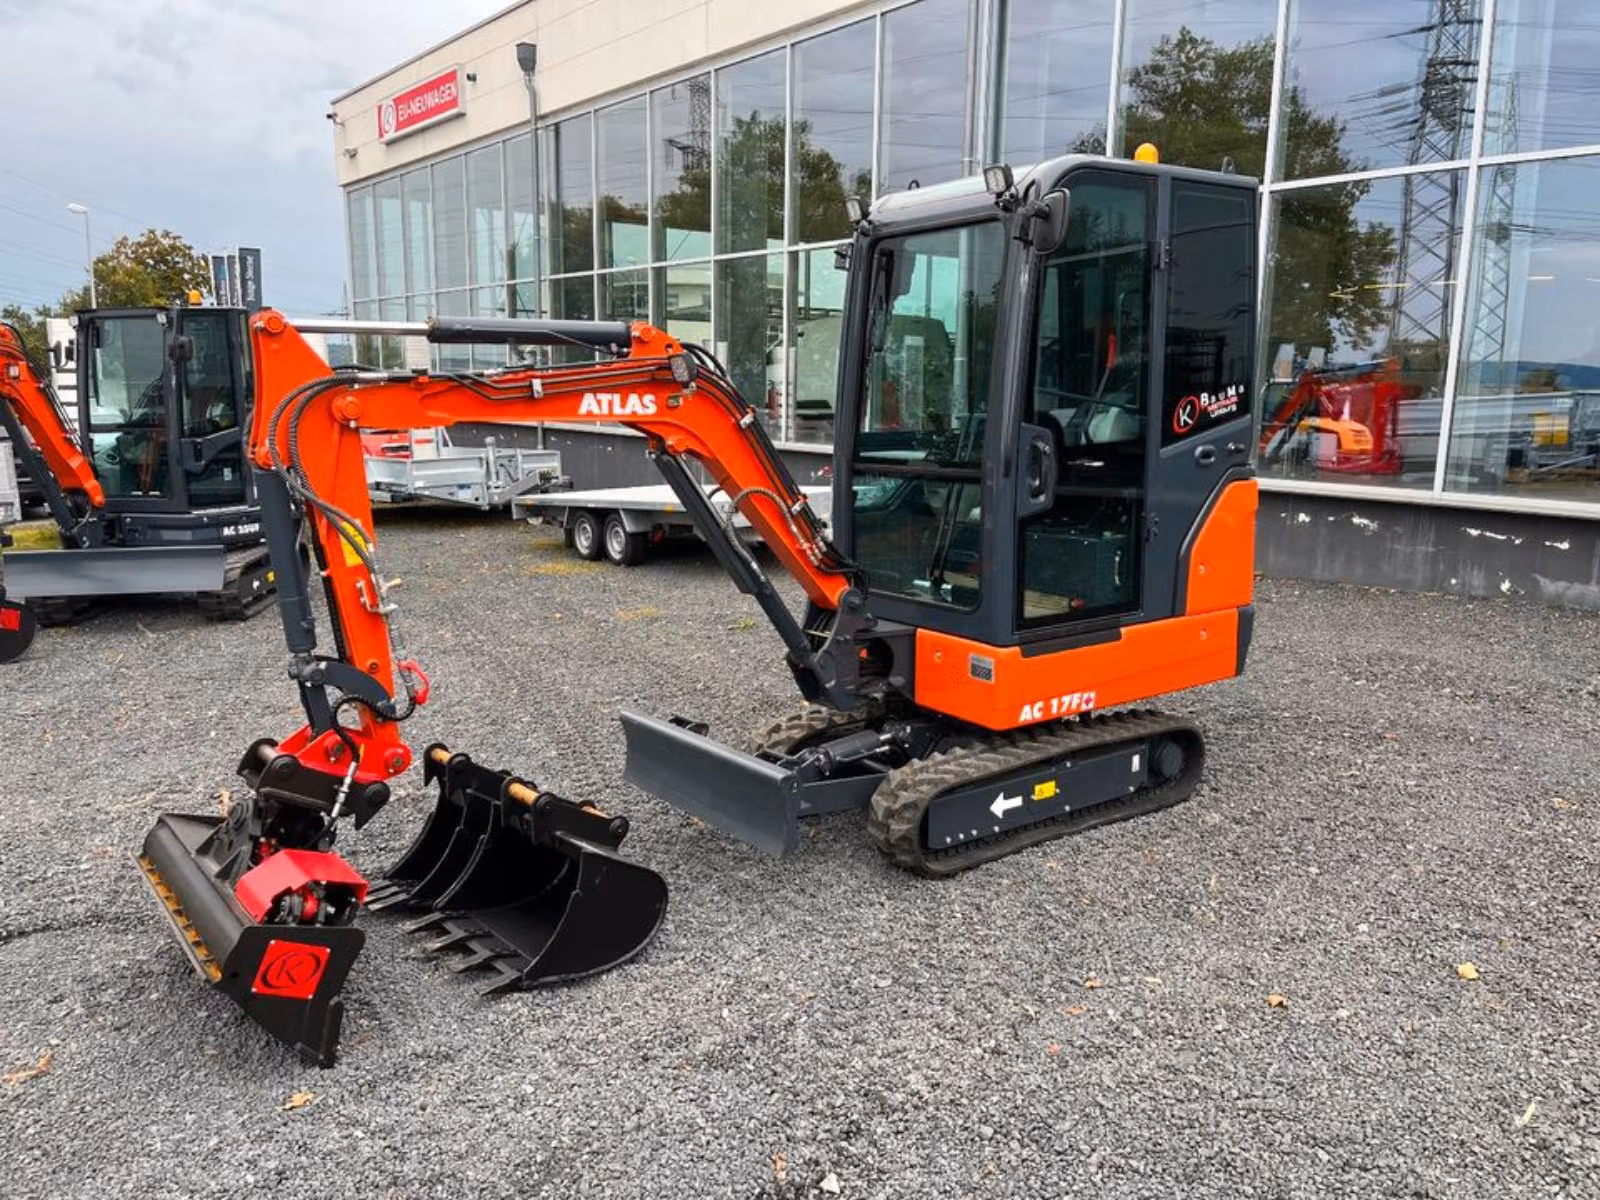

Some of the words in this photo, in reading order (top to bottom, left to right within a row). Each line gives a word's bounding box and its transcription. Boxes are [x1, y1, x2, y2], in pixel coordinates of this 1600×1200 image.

[398, 82, 458, 121] EU-NEUWAGEN
[578, 392, 657, 415] ATLAS
[1179, 404, 1193, 427] K
[223, 526, 236, 536] AC
[1018, 701, 1044, 723] AC
[275, 959, 304, 984] K
